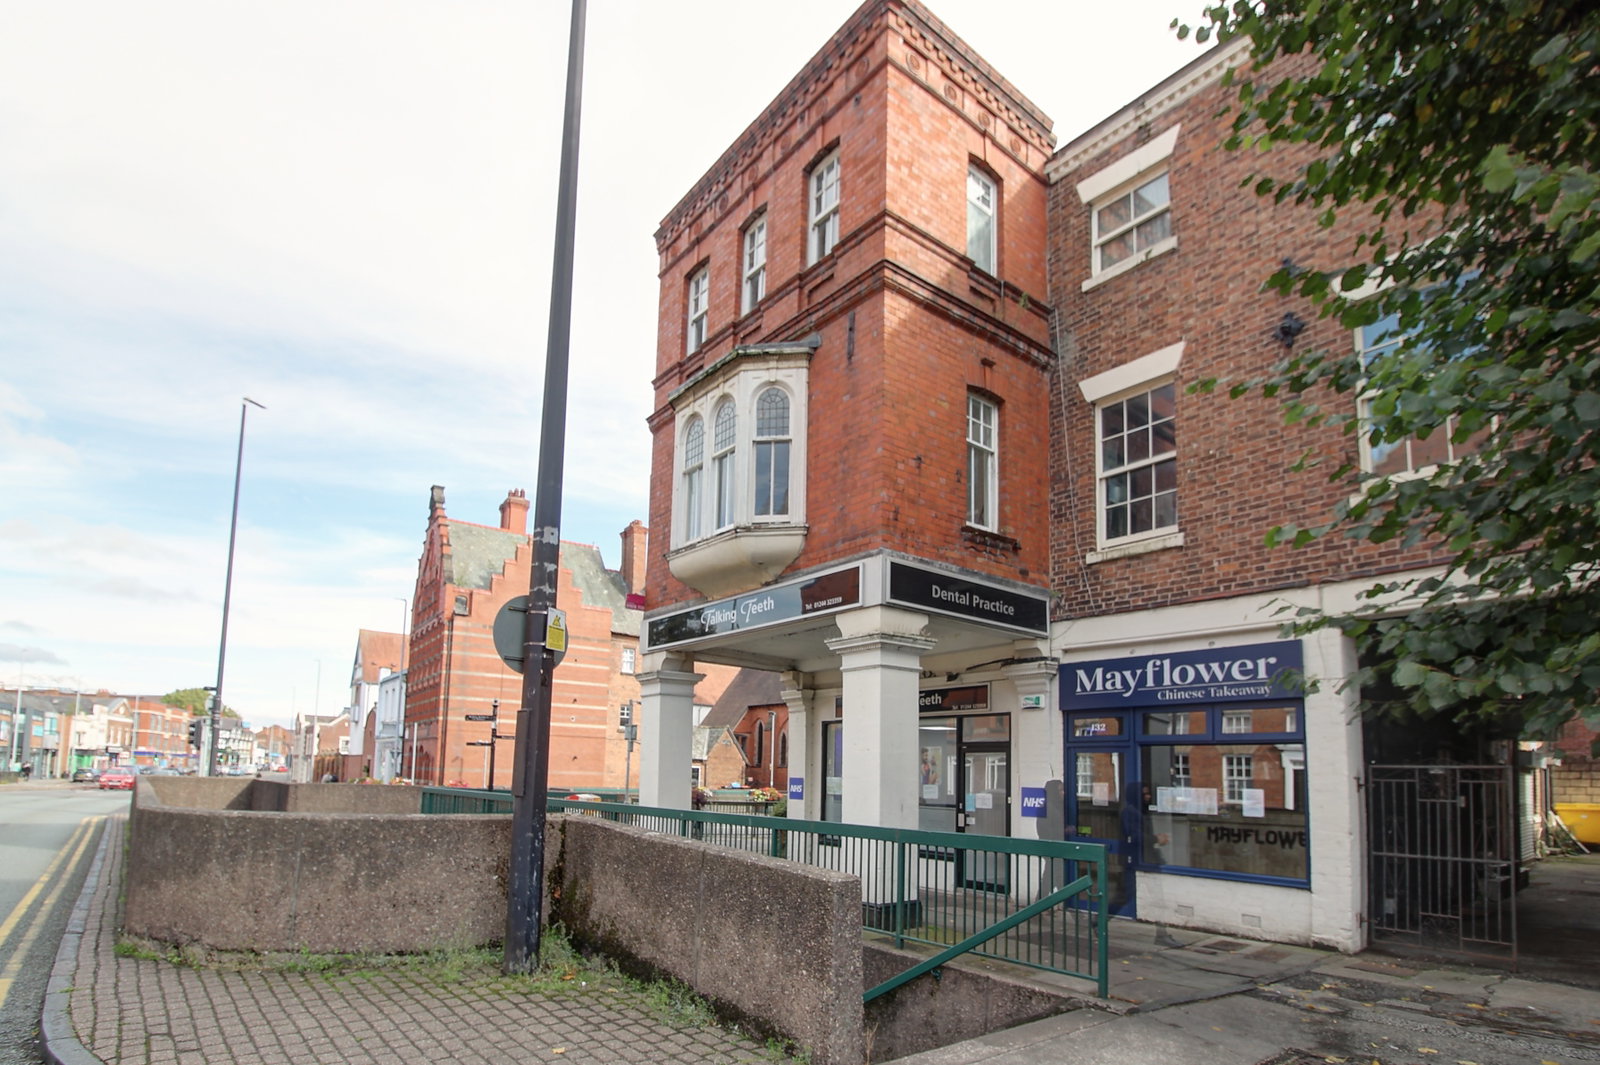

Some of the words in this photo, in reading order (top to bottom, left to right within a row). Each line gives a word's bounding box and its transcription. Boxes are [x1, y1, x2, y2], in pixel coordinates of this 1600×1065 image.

[932, 584, 969, 606] Dental
[973, 595, 1015, 616] Practice
[700, 608, 737, 632] Talking
[740, 596, 775, 623] Teeth
[1075, 657, 1278, 697] Mayflower
[919, 692, 942, 706] eeth
[1157, 689, 1206, 701] Chinese
[1208, 685, 1273, 698] Takeaway
[1091, 723, 1106, 731] 132
[790, 784, 802, 793] NHS
[1023, 796, 1045, 808] NHS
